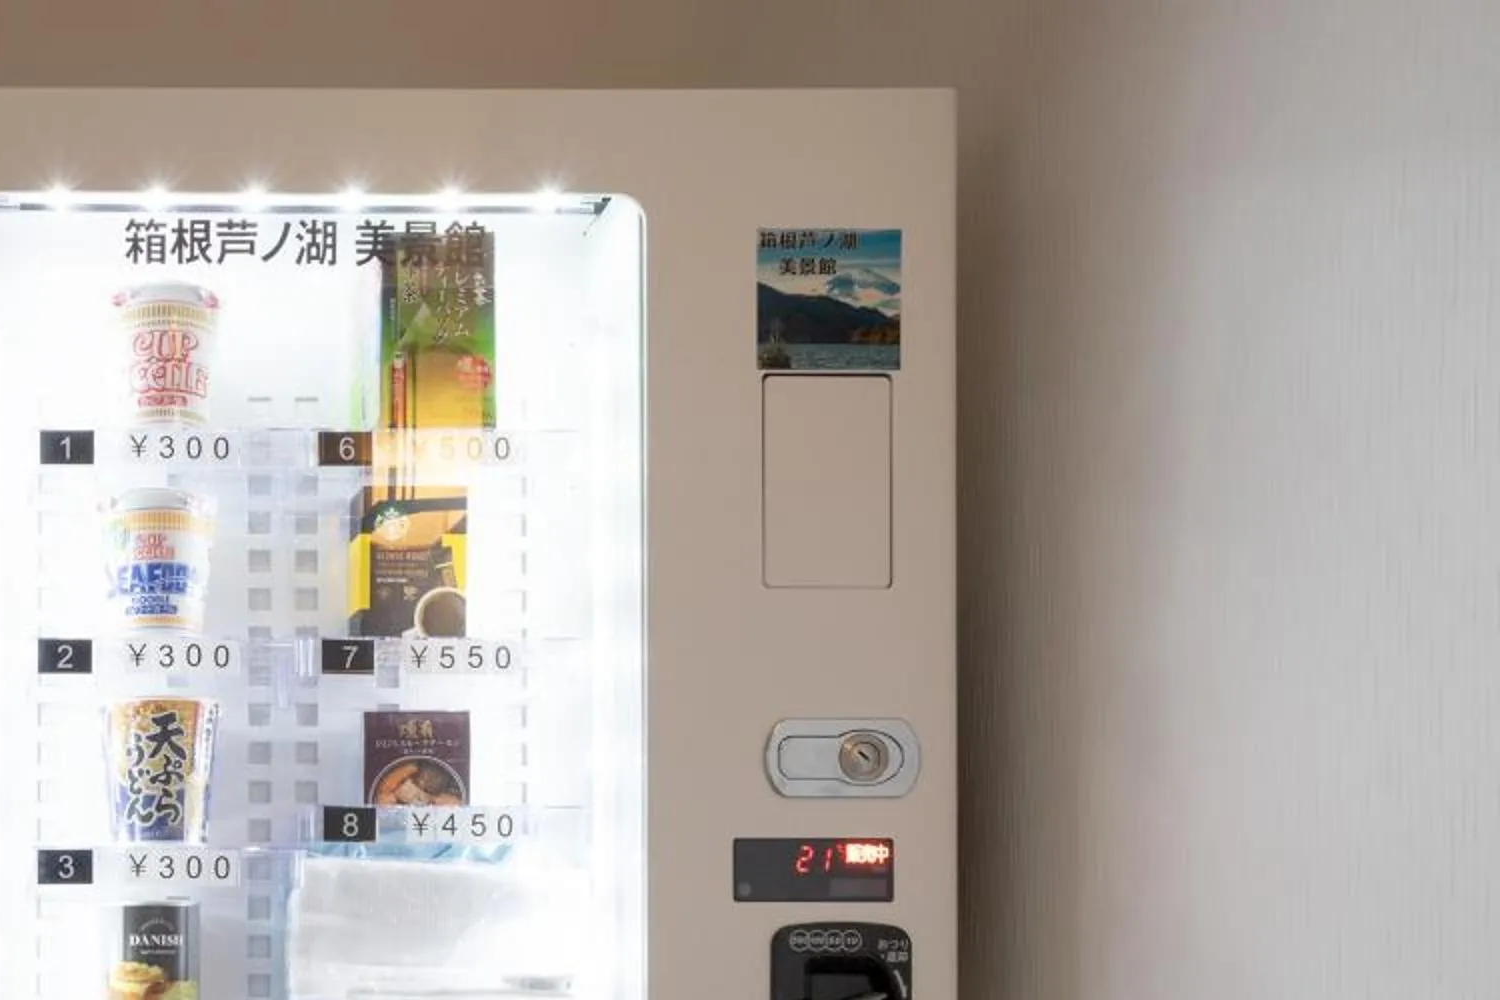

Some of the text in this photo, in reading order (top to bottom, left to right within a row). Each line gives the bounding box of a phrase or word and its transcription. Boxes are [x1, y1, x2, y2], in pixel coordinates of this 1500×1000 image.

[125, 219, 487, 267] 箱根芦ノ湖 美景館
[760, 232, 858, 249] 箱根芦ノ湖
[59, 435, 72, 460] 1
[131, 434, 229, 459] ¥300
[339, 436, 356, 460] 6
[412, 437, 510, 460] 500
[57, 645, 73, 669] 2
[129, 643, 229, 668] ¥300
[341, 645, 358, 669] 7
[410, 645, 511, 669] ¥550
[126, 733, 155, 824] うどん
[146, 711, 187, 824] 天ぷら
[341, 812, 359, 837] 8
[412, 813, 513, 837] ¥450
[58, 855, 75, 879] 3
[129, 854, 230, 879] ¥300
[129, 933, 184, 946] DANISH
